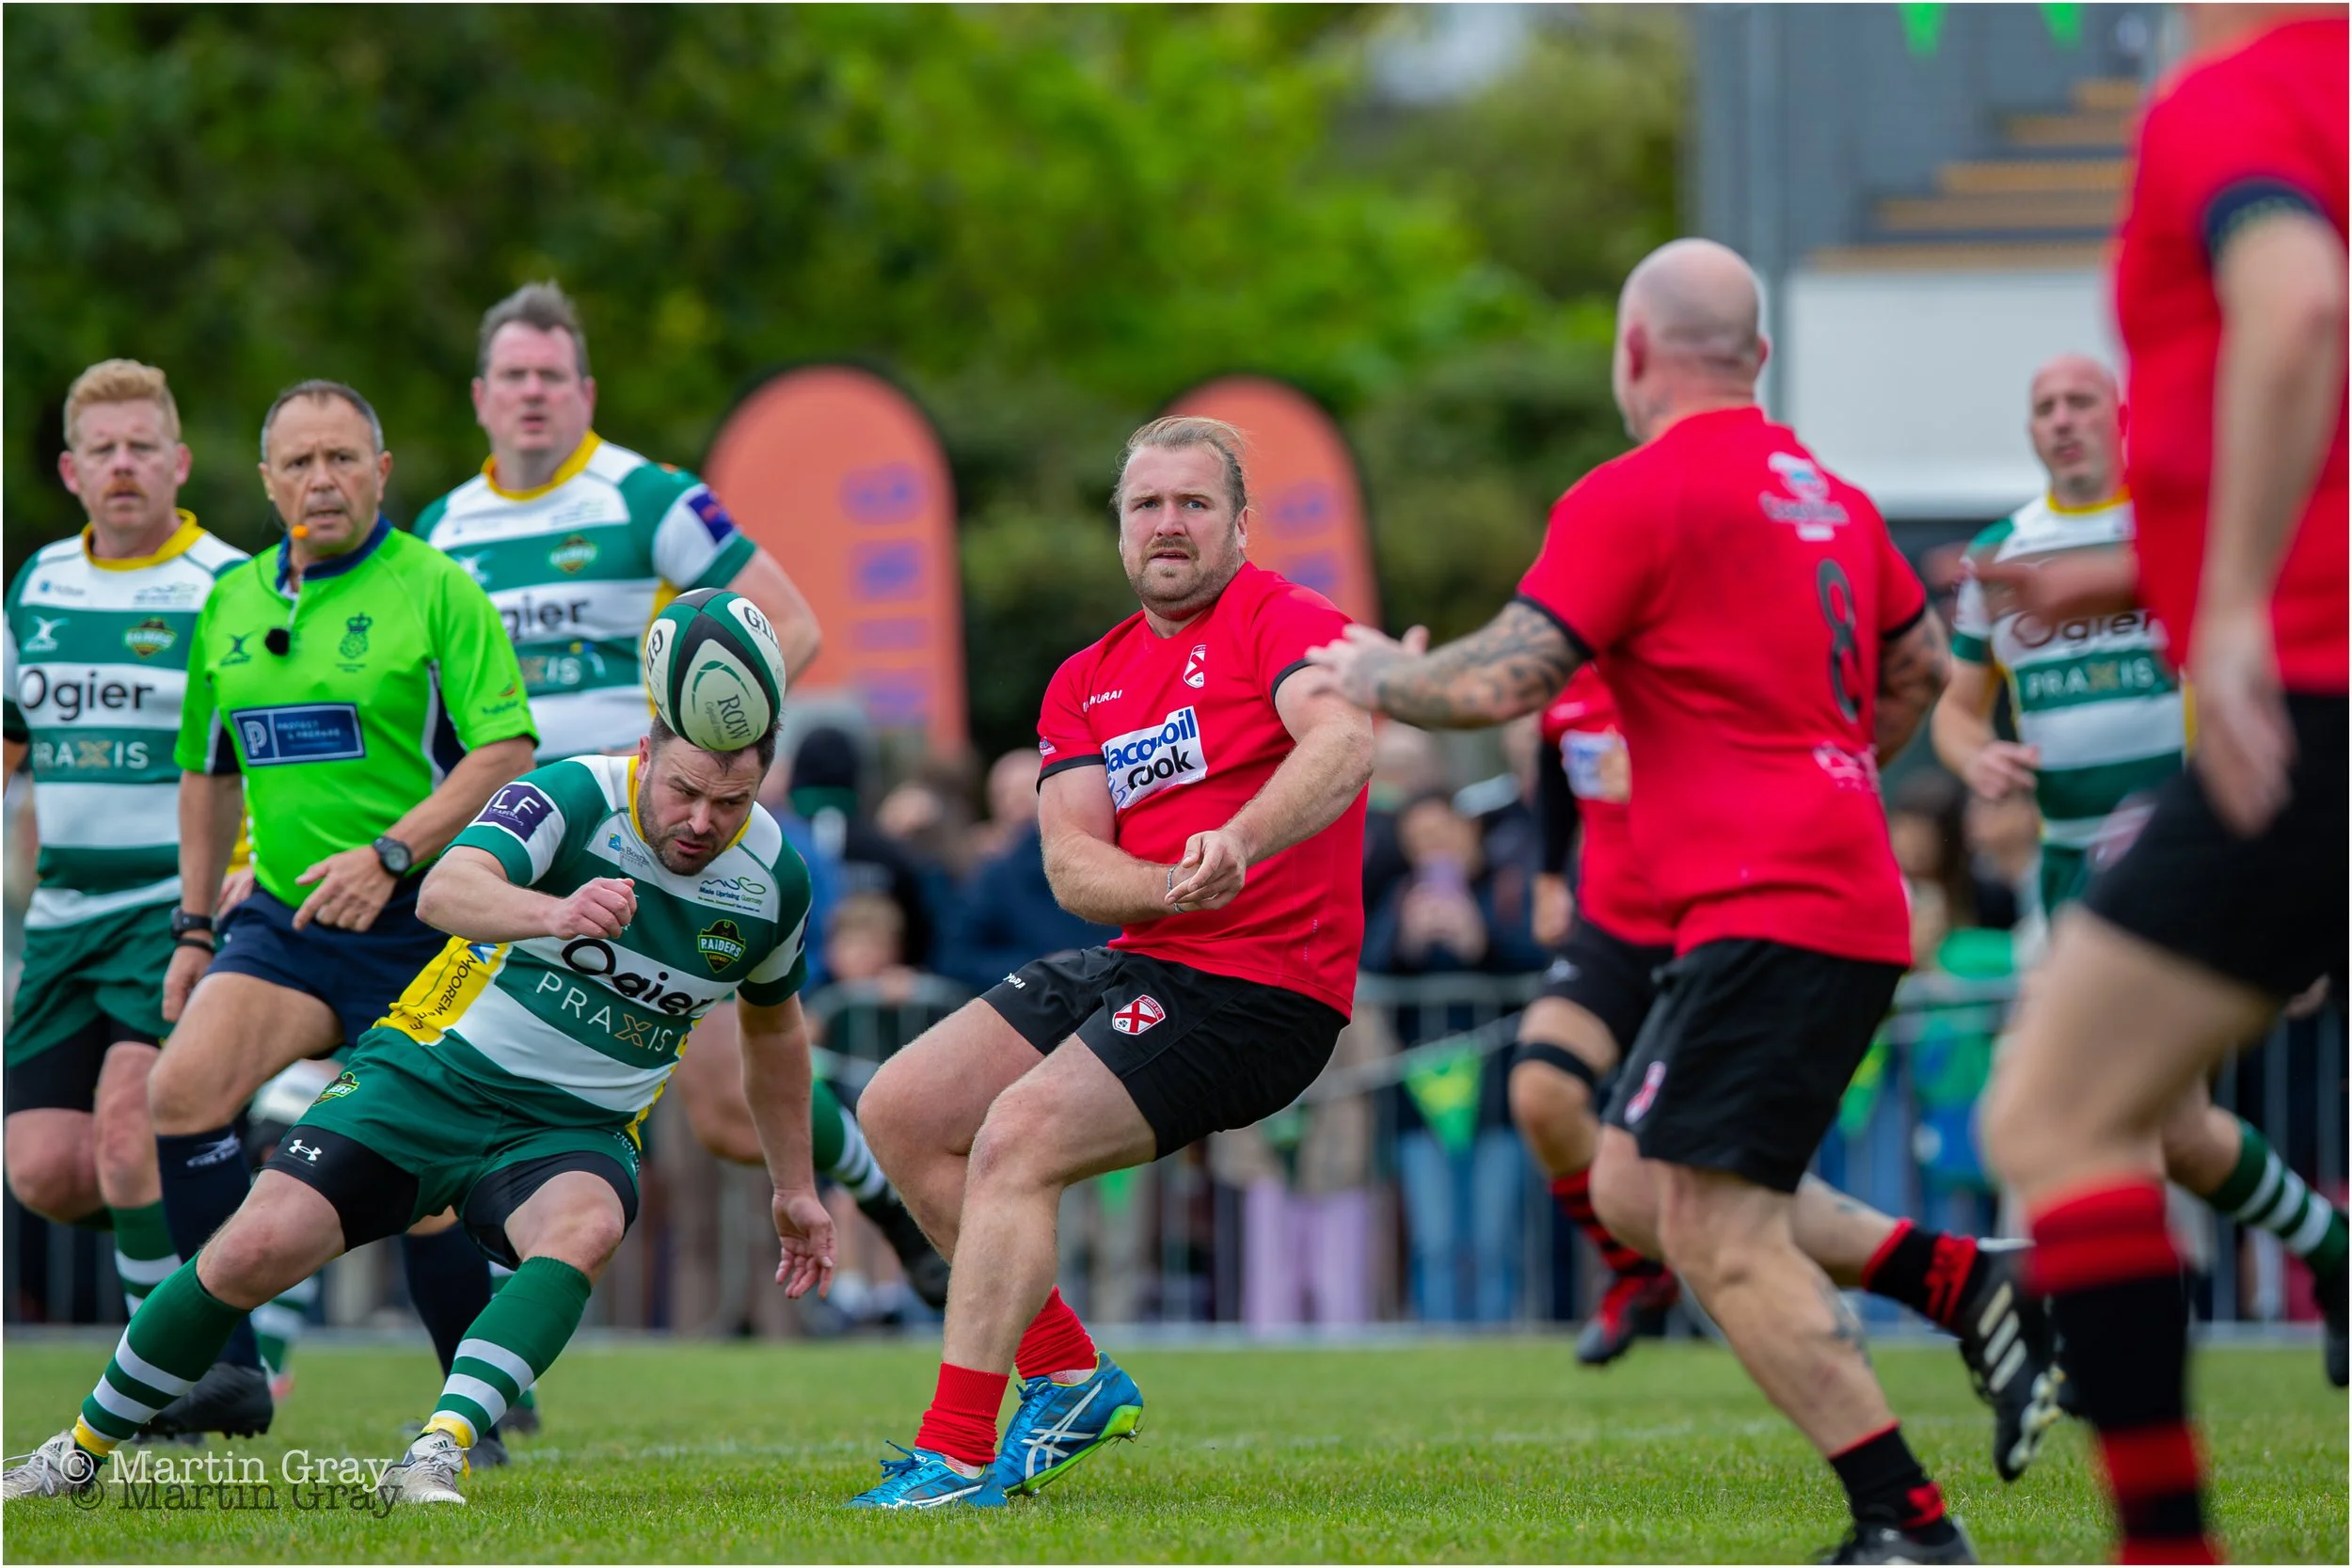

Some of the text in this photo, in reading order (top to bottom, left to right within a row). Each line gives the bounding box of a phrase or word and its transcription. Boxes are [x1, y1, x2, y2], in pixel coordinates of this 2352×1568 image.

[1816, 558, 1862, 724] 8
[20, 669, 154, 721] Ogier
[2026, 657, 2155, 702] PRAXIS
[700, 938, 741, 958] RAIDERS
[535, 971, 673, 1052] PRAXIS
